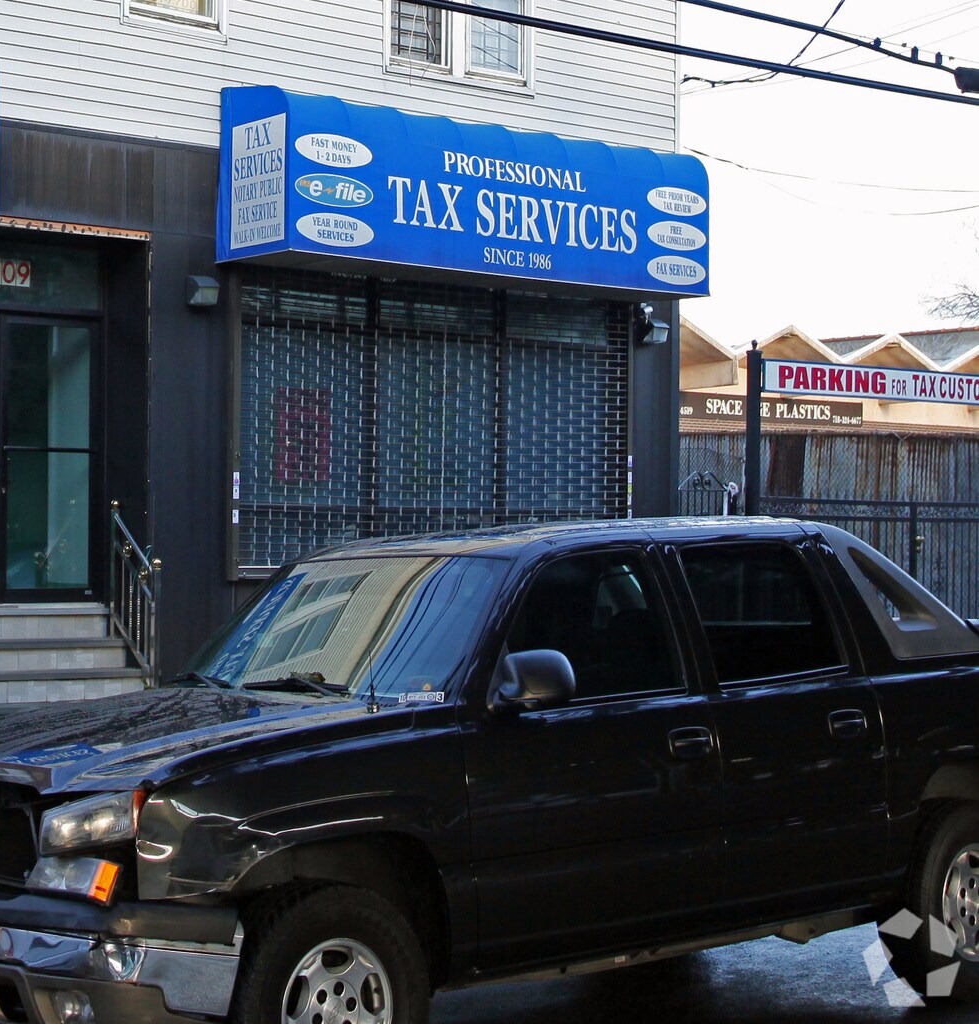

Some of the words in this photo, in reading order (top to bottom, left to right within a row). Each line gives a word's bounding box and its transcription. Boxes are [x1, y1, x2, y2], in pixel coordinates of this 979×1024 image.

[245, 122, 272, 150] TAX
[311, 137, 329, 149] FAST
[331, 140, 358, 154] MONEY
[234, 148, 283, 181] SERVICES
[332, 152, 352, 164] DAYS
[443, 151, 587, 192] PROFESSIONAL
[234, 180, 258, 204] NOTARY
[259, 176, 283, 198] PUBLIC
[655, 189, 667, 198] FREE
[668, 191, 683, 202] PRIOR
[683, 194, 700, 205] YEARS
[237, 204, 250, 225] FAX
[251, 201, 277, 222] SERVICE
[388, 176, 464, 232] TAX
[476, 189, 638, 254] SERVICES
[663, 201, 673, 210] TAX
[674, 203, 692, 214] REVIEW
[234, 227, 256, 245] WALK-IN
[257, 223, 281, 241] WELCOME
[312, 217, 331, 227] YEAR
[334, 219, 358, 231] ROUND
[670, 225, 682, 235] FREE
[317, 229, 355, 242] SERVICES
[657, 234, 665, 243] TAX
[483, 247, 525, 267] SINCE
[528, 253, 552, 270] 1986
[656, 262, 668, 275] FAX
[669, 263, 697, 278] SERVICES
[778, 365, 886, 395] PARKING
[891, 378, 907, 396] FOR
[912, 374, 937, 398] TAX
[705, 398, 743, 416] SPACE
[775, 402, 831, 420] PLASTICS
